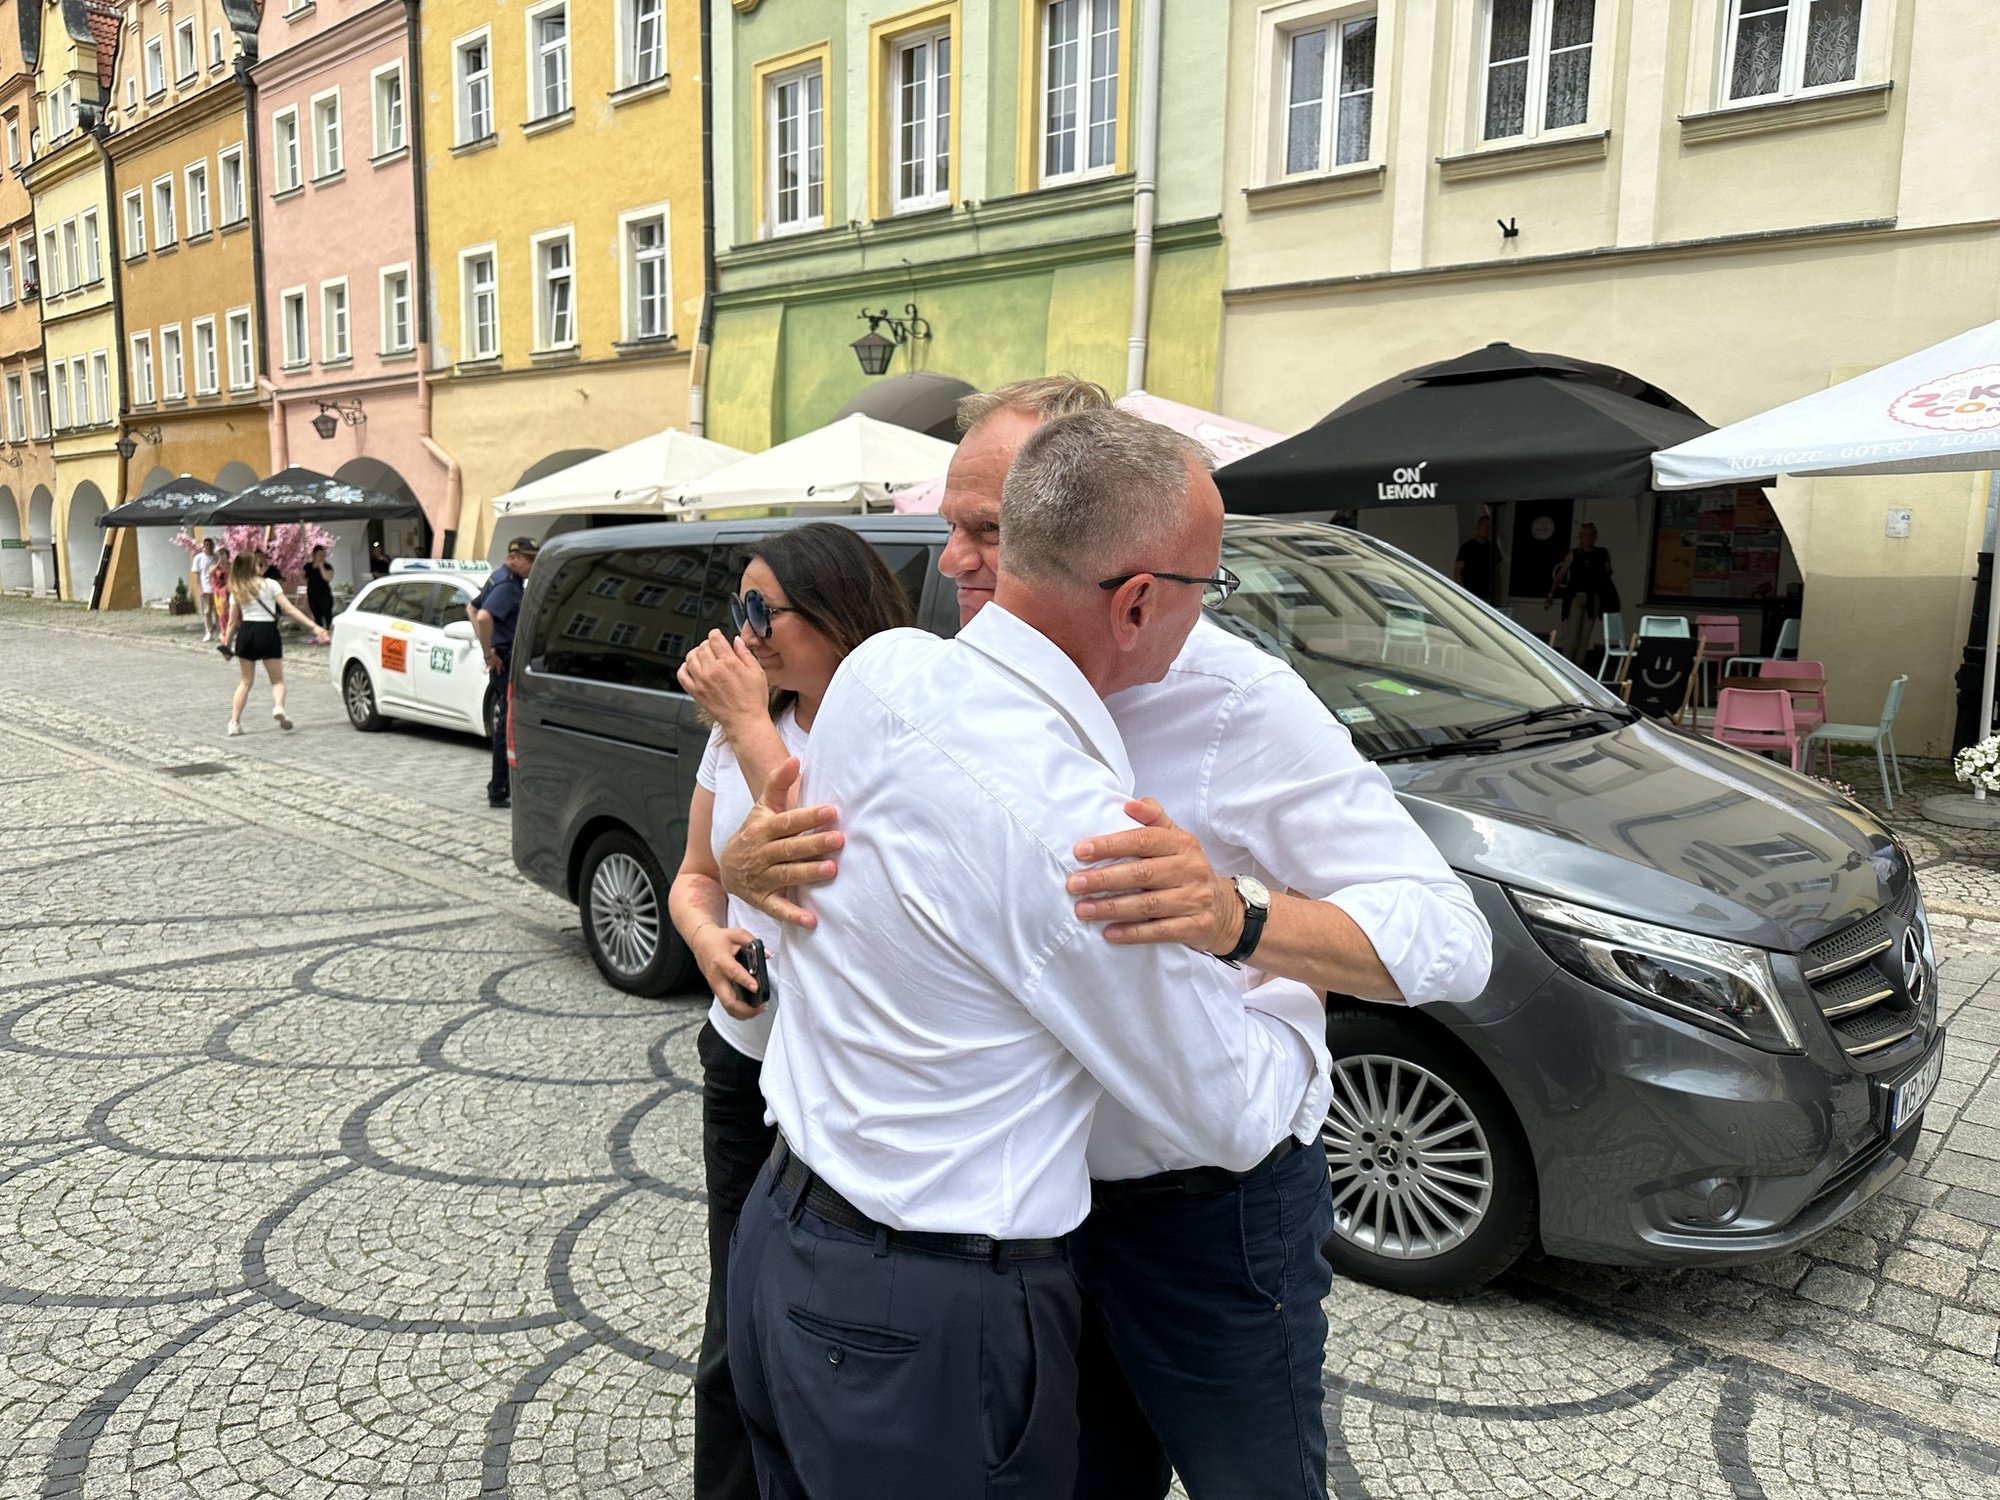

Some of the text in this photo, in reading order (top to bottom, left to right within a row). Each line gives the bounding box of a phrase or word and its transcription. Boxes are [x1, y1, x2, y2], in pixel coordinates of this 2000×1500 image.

[1840, 440, 1920, 458] GOFRY
[1393, 467, 1420, 483] ON
[1378, 482, 1436, 500] LEMON
